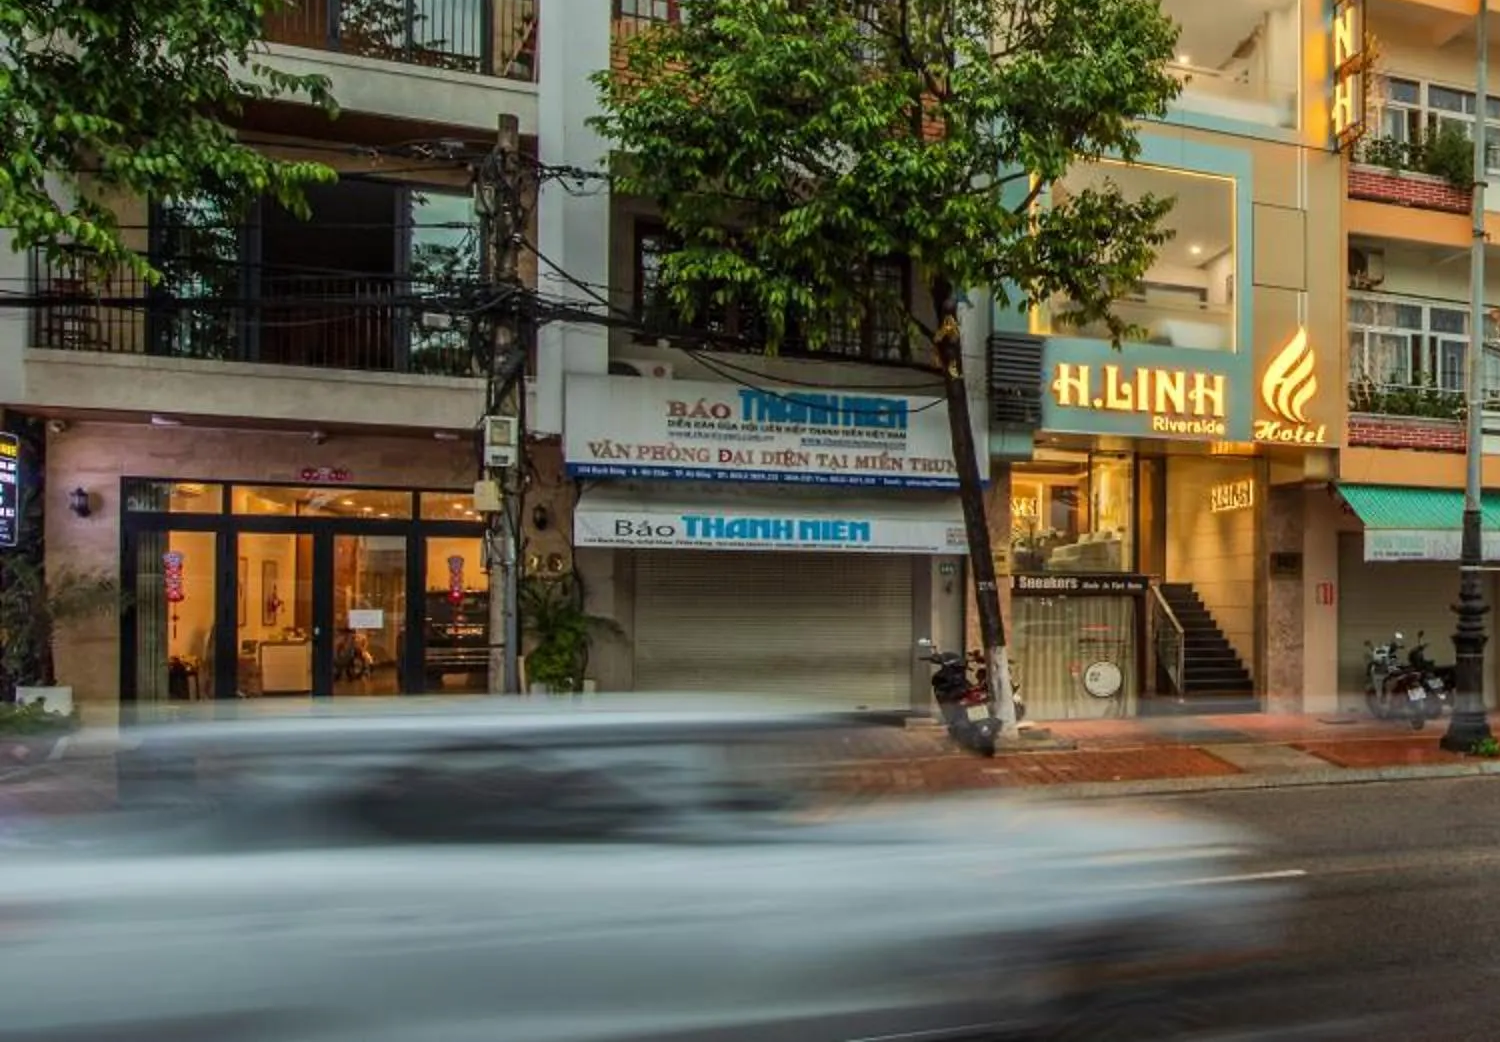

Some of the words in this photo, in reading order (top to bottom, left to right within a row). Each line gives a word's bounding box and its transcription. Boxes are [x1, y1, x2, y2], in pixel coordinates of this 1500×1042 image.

[1053, 362, 1225, 417] H.LINH
[1153, 416, 1225, 435] Riverside
[1255, 419, 1327, 443] Hotel
[907, 457, 957, 473] TRUN
[615, 518, 676, 537] Báo
[1019, 575, 1078, 589] Sneakers
